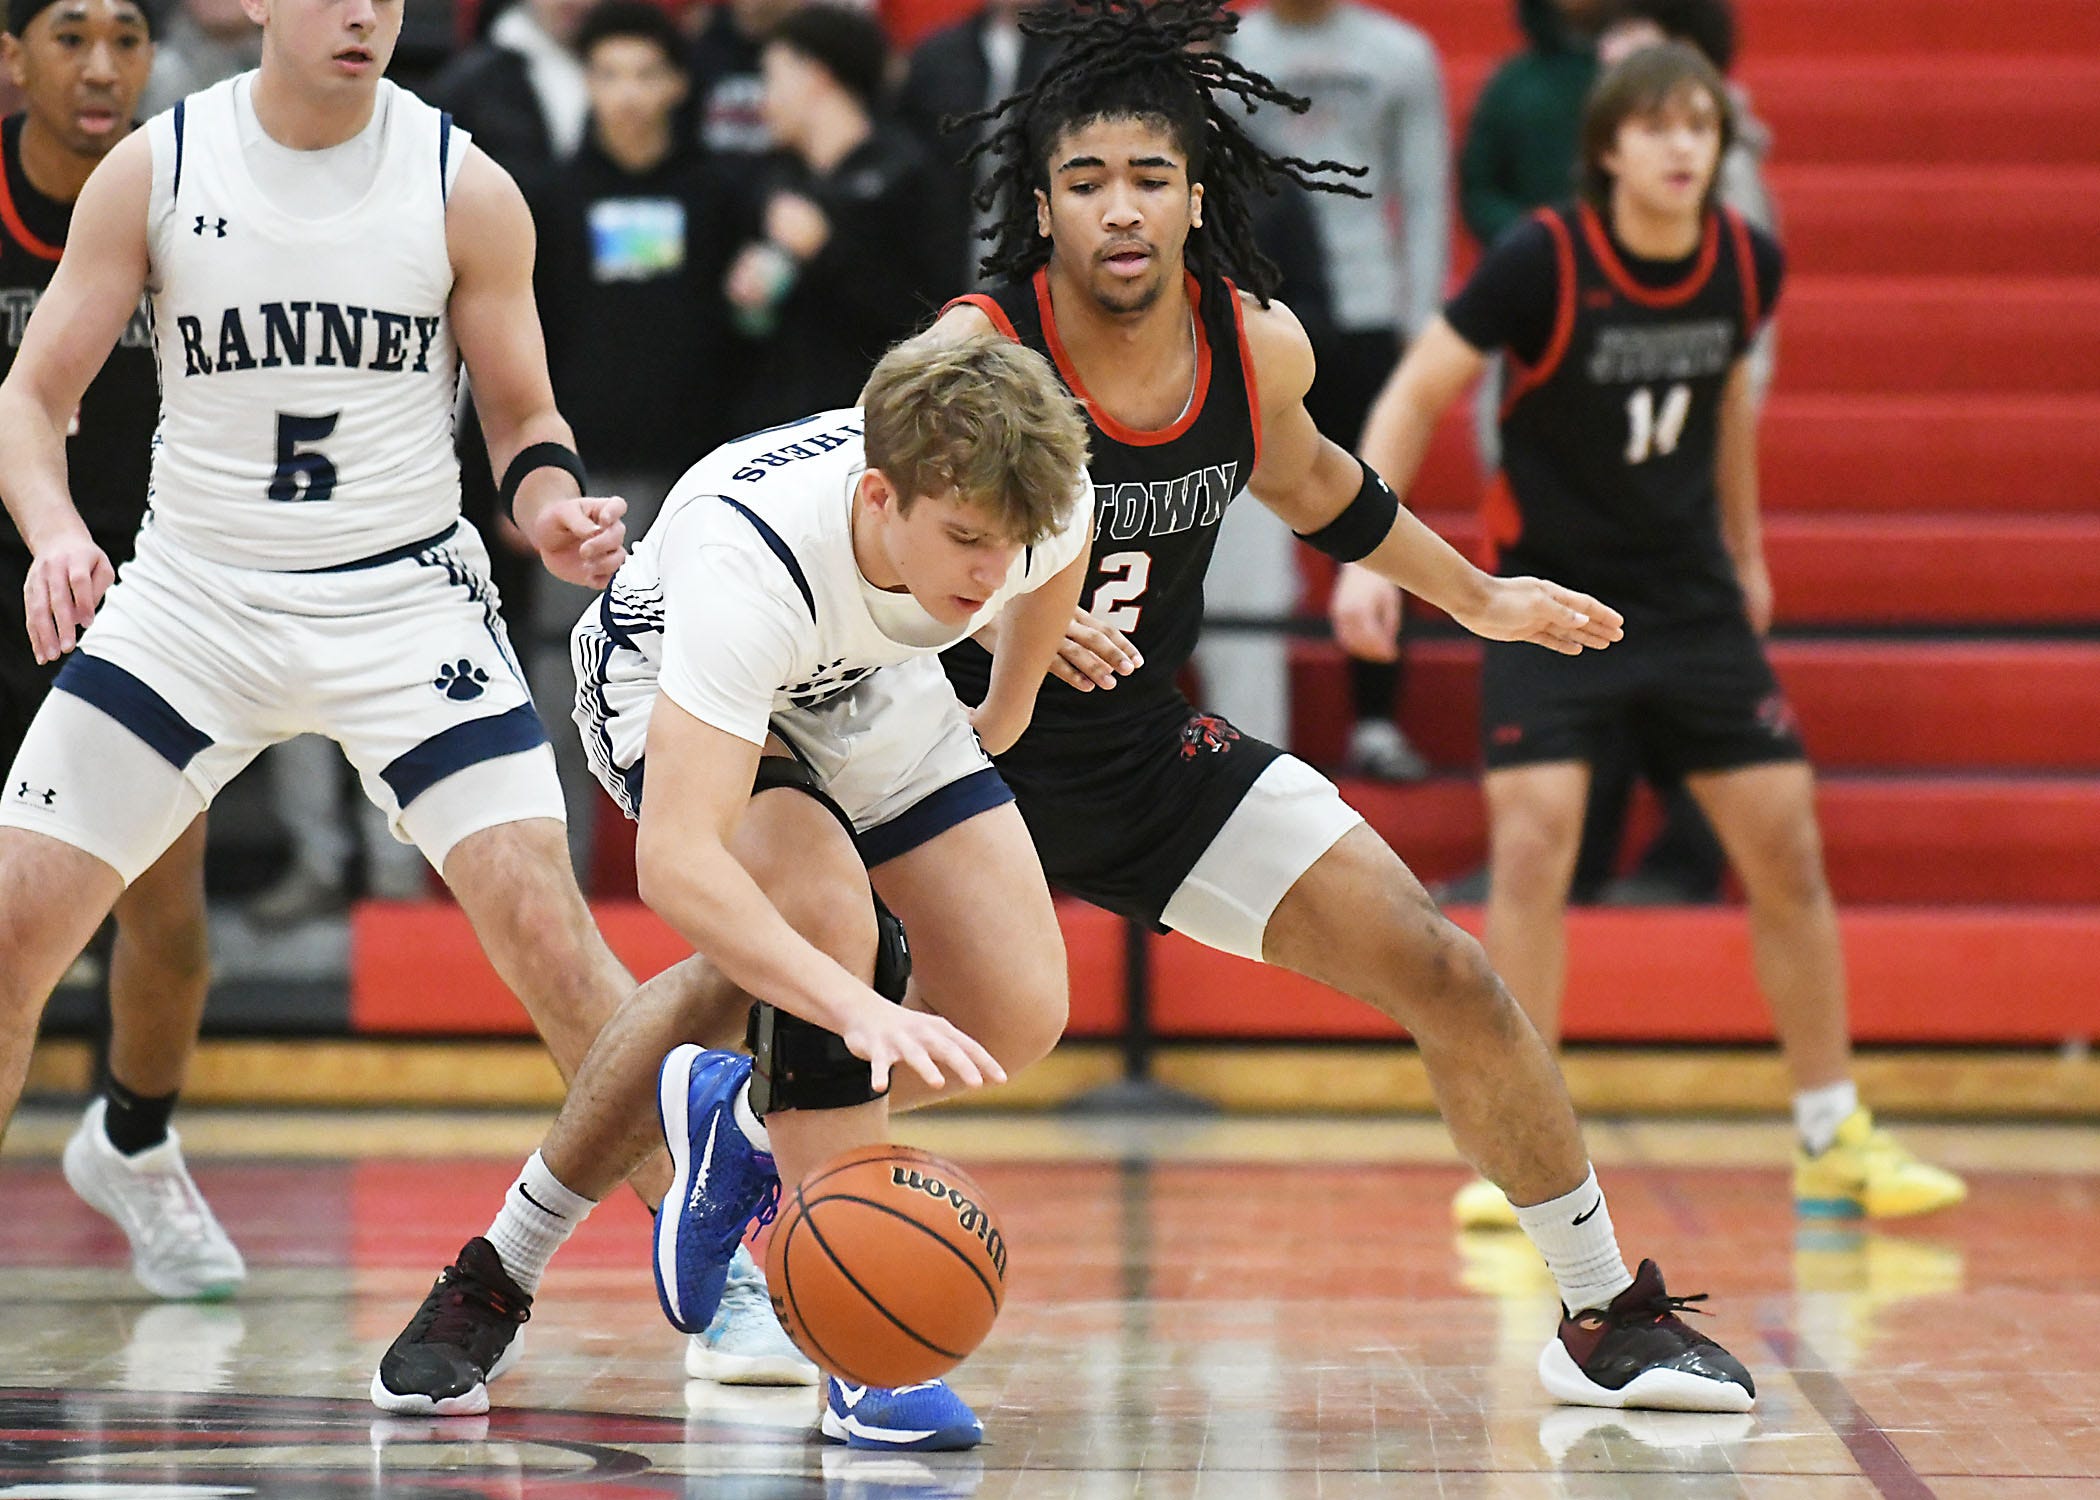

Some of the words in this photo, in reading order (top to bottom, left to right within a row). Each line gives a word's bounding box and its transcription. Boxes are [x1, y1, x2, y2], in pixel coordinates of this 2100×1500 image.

[177, 301, 440, 377] RANNEY
[267, 410, 342, 502] 5
[732, 418, 865, 482] THERS
[1091, 551, 1151, 632] 2
[890, 1165, 1007, 1282] Wilson
